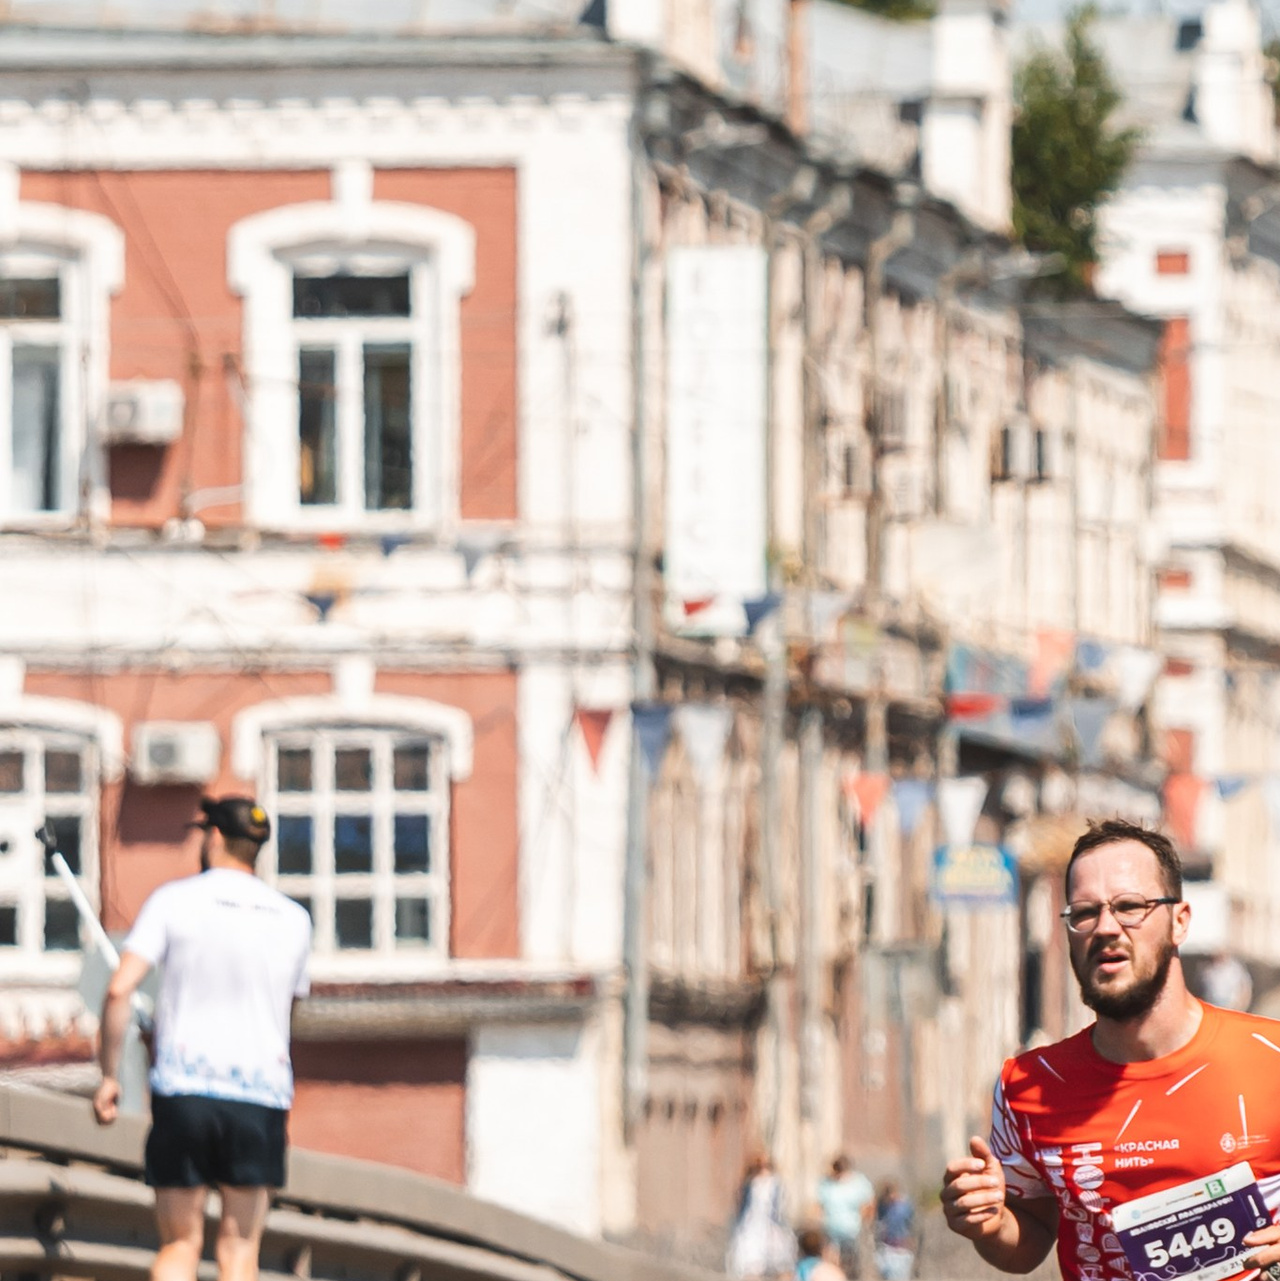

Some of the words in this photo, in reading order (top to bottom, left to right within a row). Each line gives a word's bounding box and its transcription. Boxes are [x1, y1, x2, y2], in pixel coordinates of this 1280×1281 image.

[1114, 1139, 1180, 1153] «КРАСНАЯ
[1115, 1156, 1154, 1168] НИТЬ»
[1144, 1217, 1235, 1268] 5449
